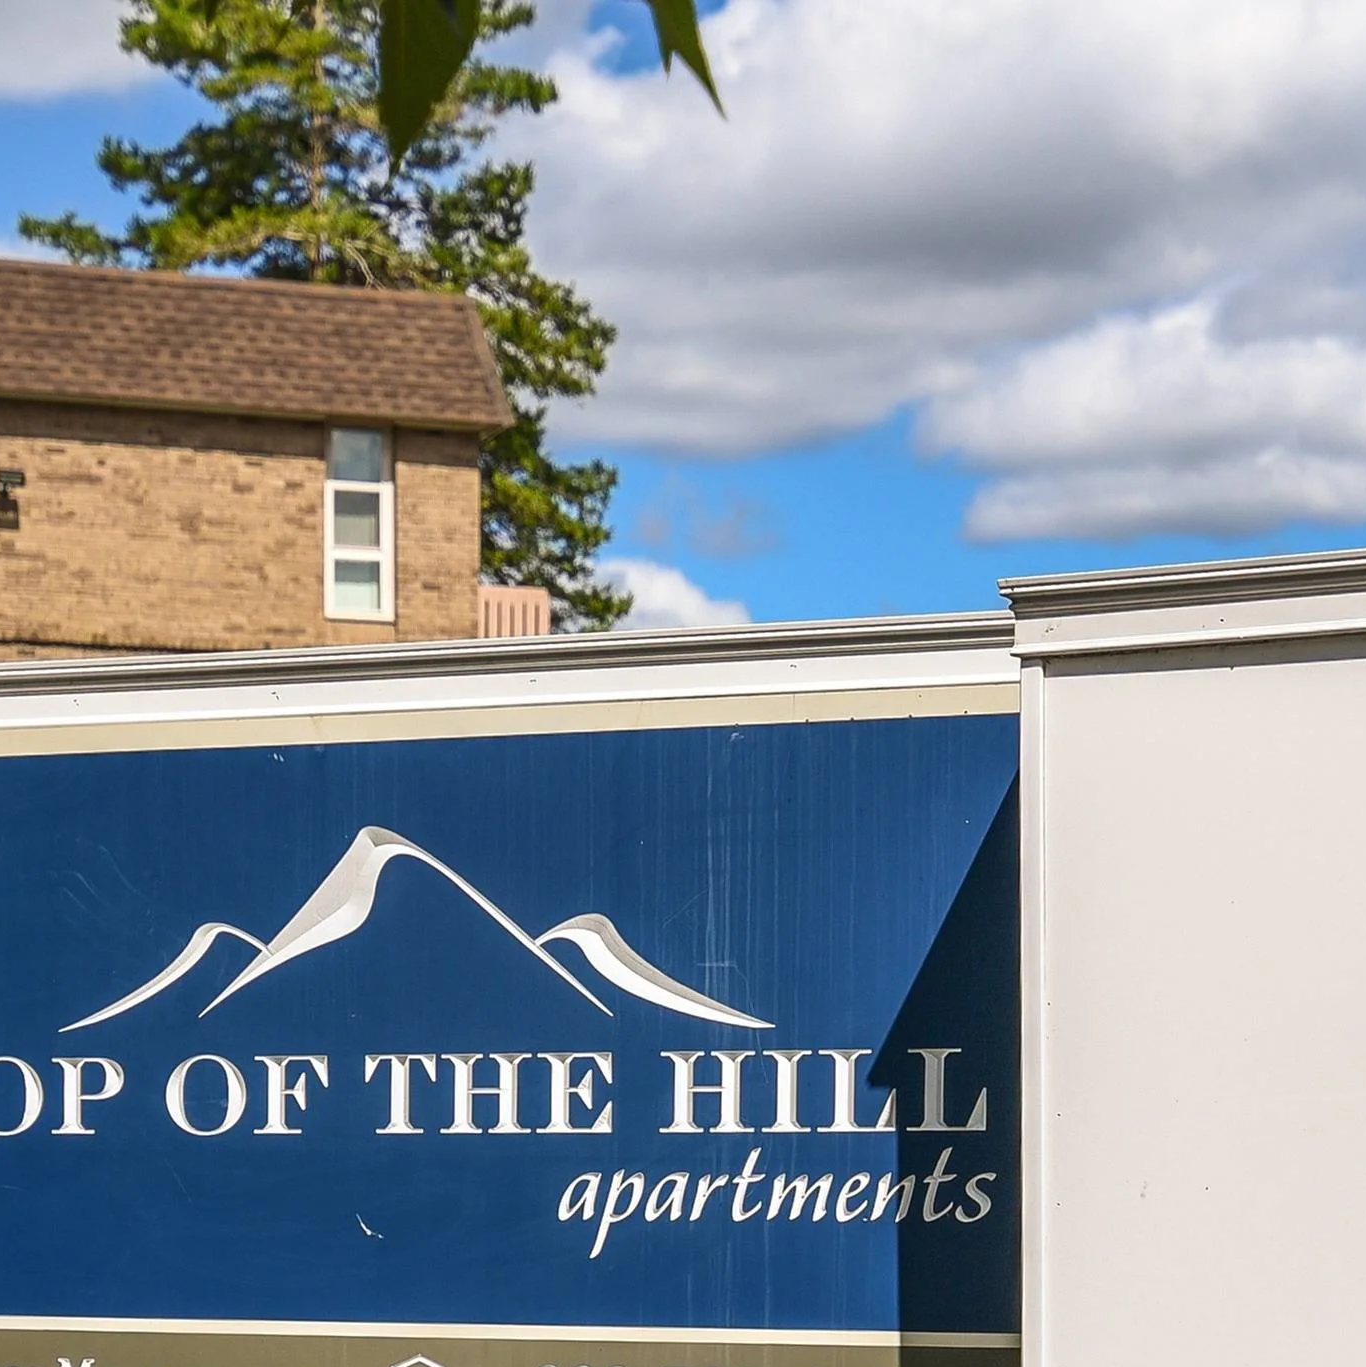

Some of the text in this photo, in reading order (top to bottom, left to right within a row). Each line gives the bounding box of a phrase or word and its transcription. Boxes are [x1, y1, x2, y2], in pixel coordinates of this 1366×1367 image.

[165, 1054, 329, 1137] OF
[364, 1051, 614, 1135] THE
[657, 1047, 988, 1134] HILL
[556, 1146, 997, 1259] apartments
